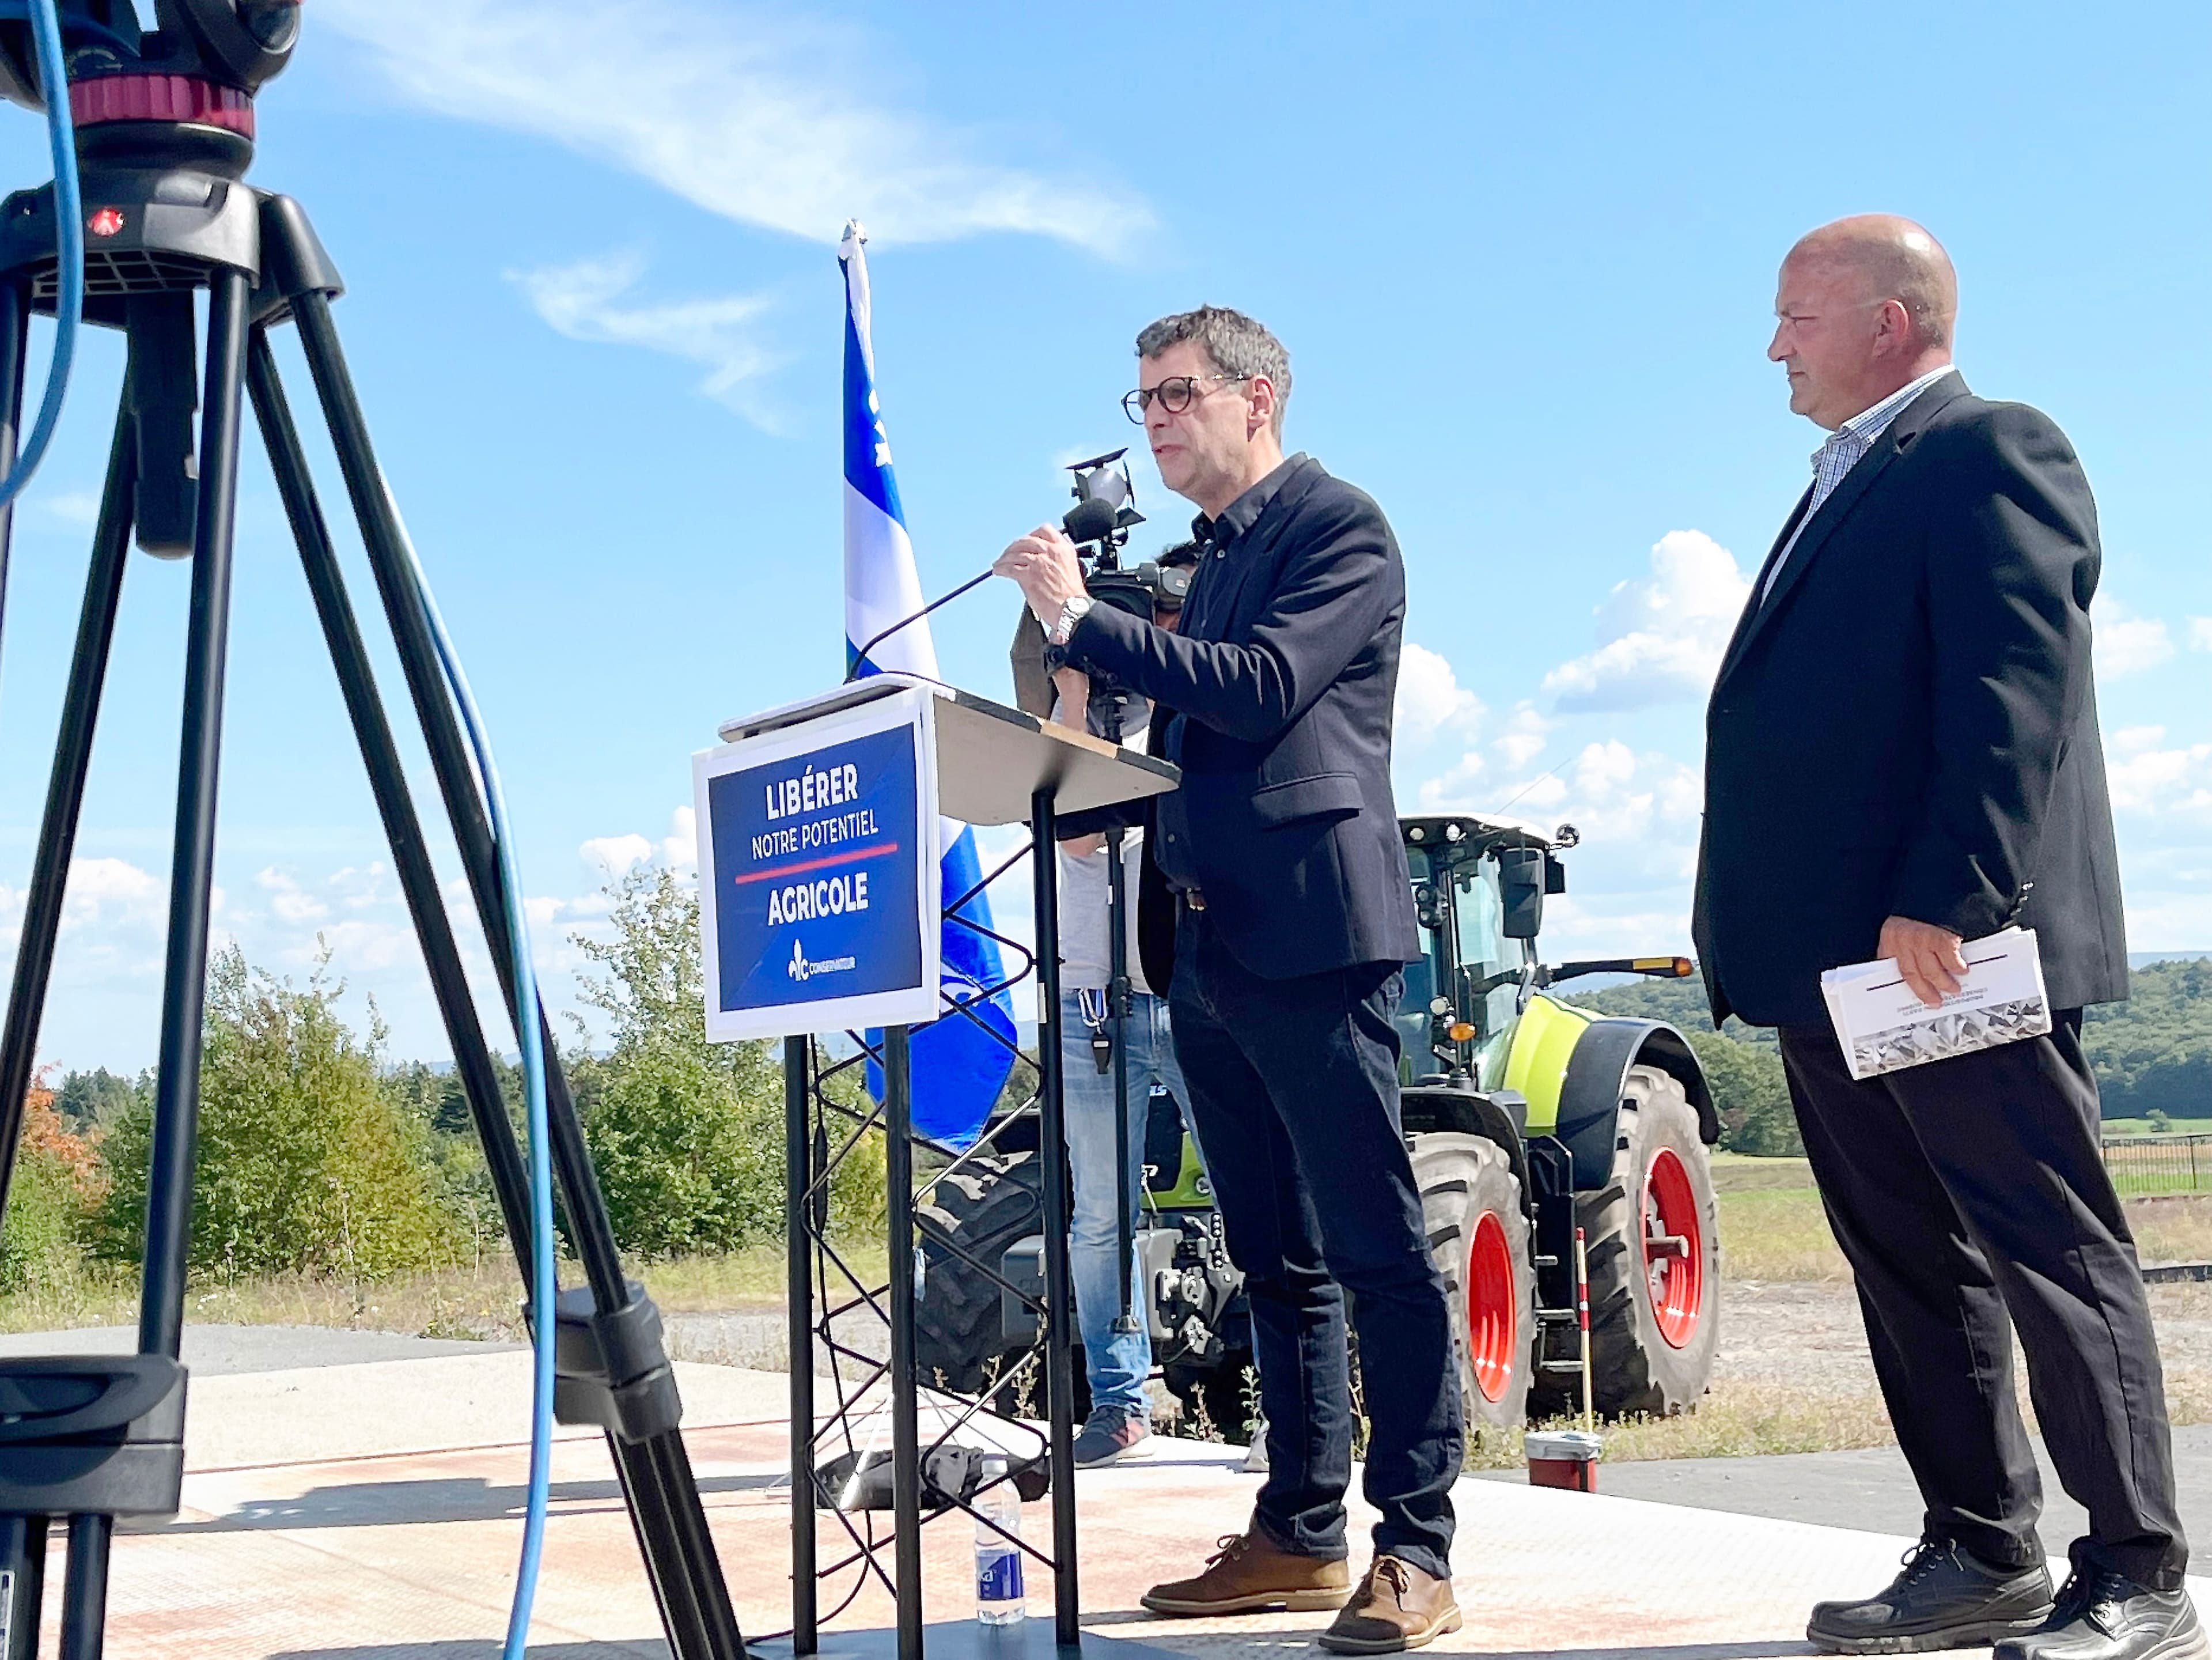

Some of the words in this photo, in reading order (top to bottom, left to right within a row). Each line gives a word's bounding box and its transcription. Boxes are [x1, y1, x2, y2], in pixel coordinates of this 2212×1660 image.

[766, 763, 858, 820] LIBÉRER
[752, 827, 799, 860] NOTRE
[802, 809, 879, 849] POTENTIEL
[768, 872, 868, 926] AGRICOLE
